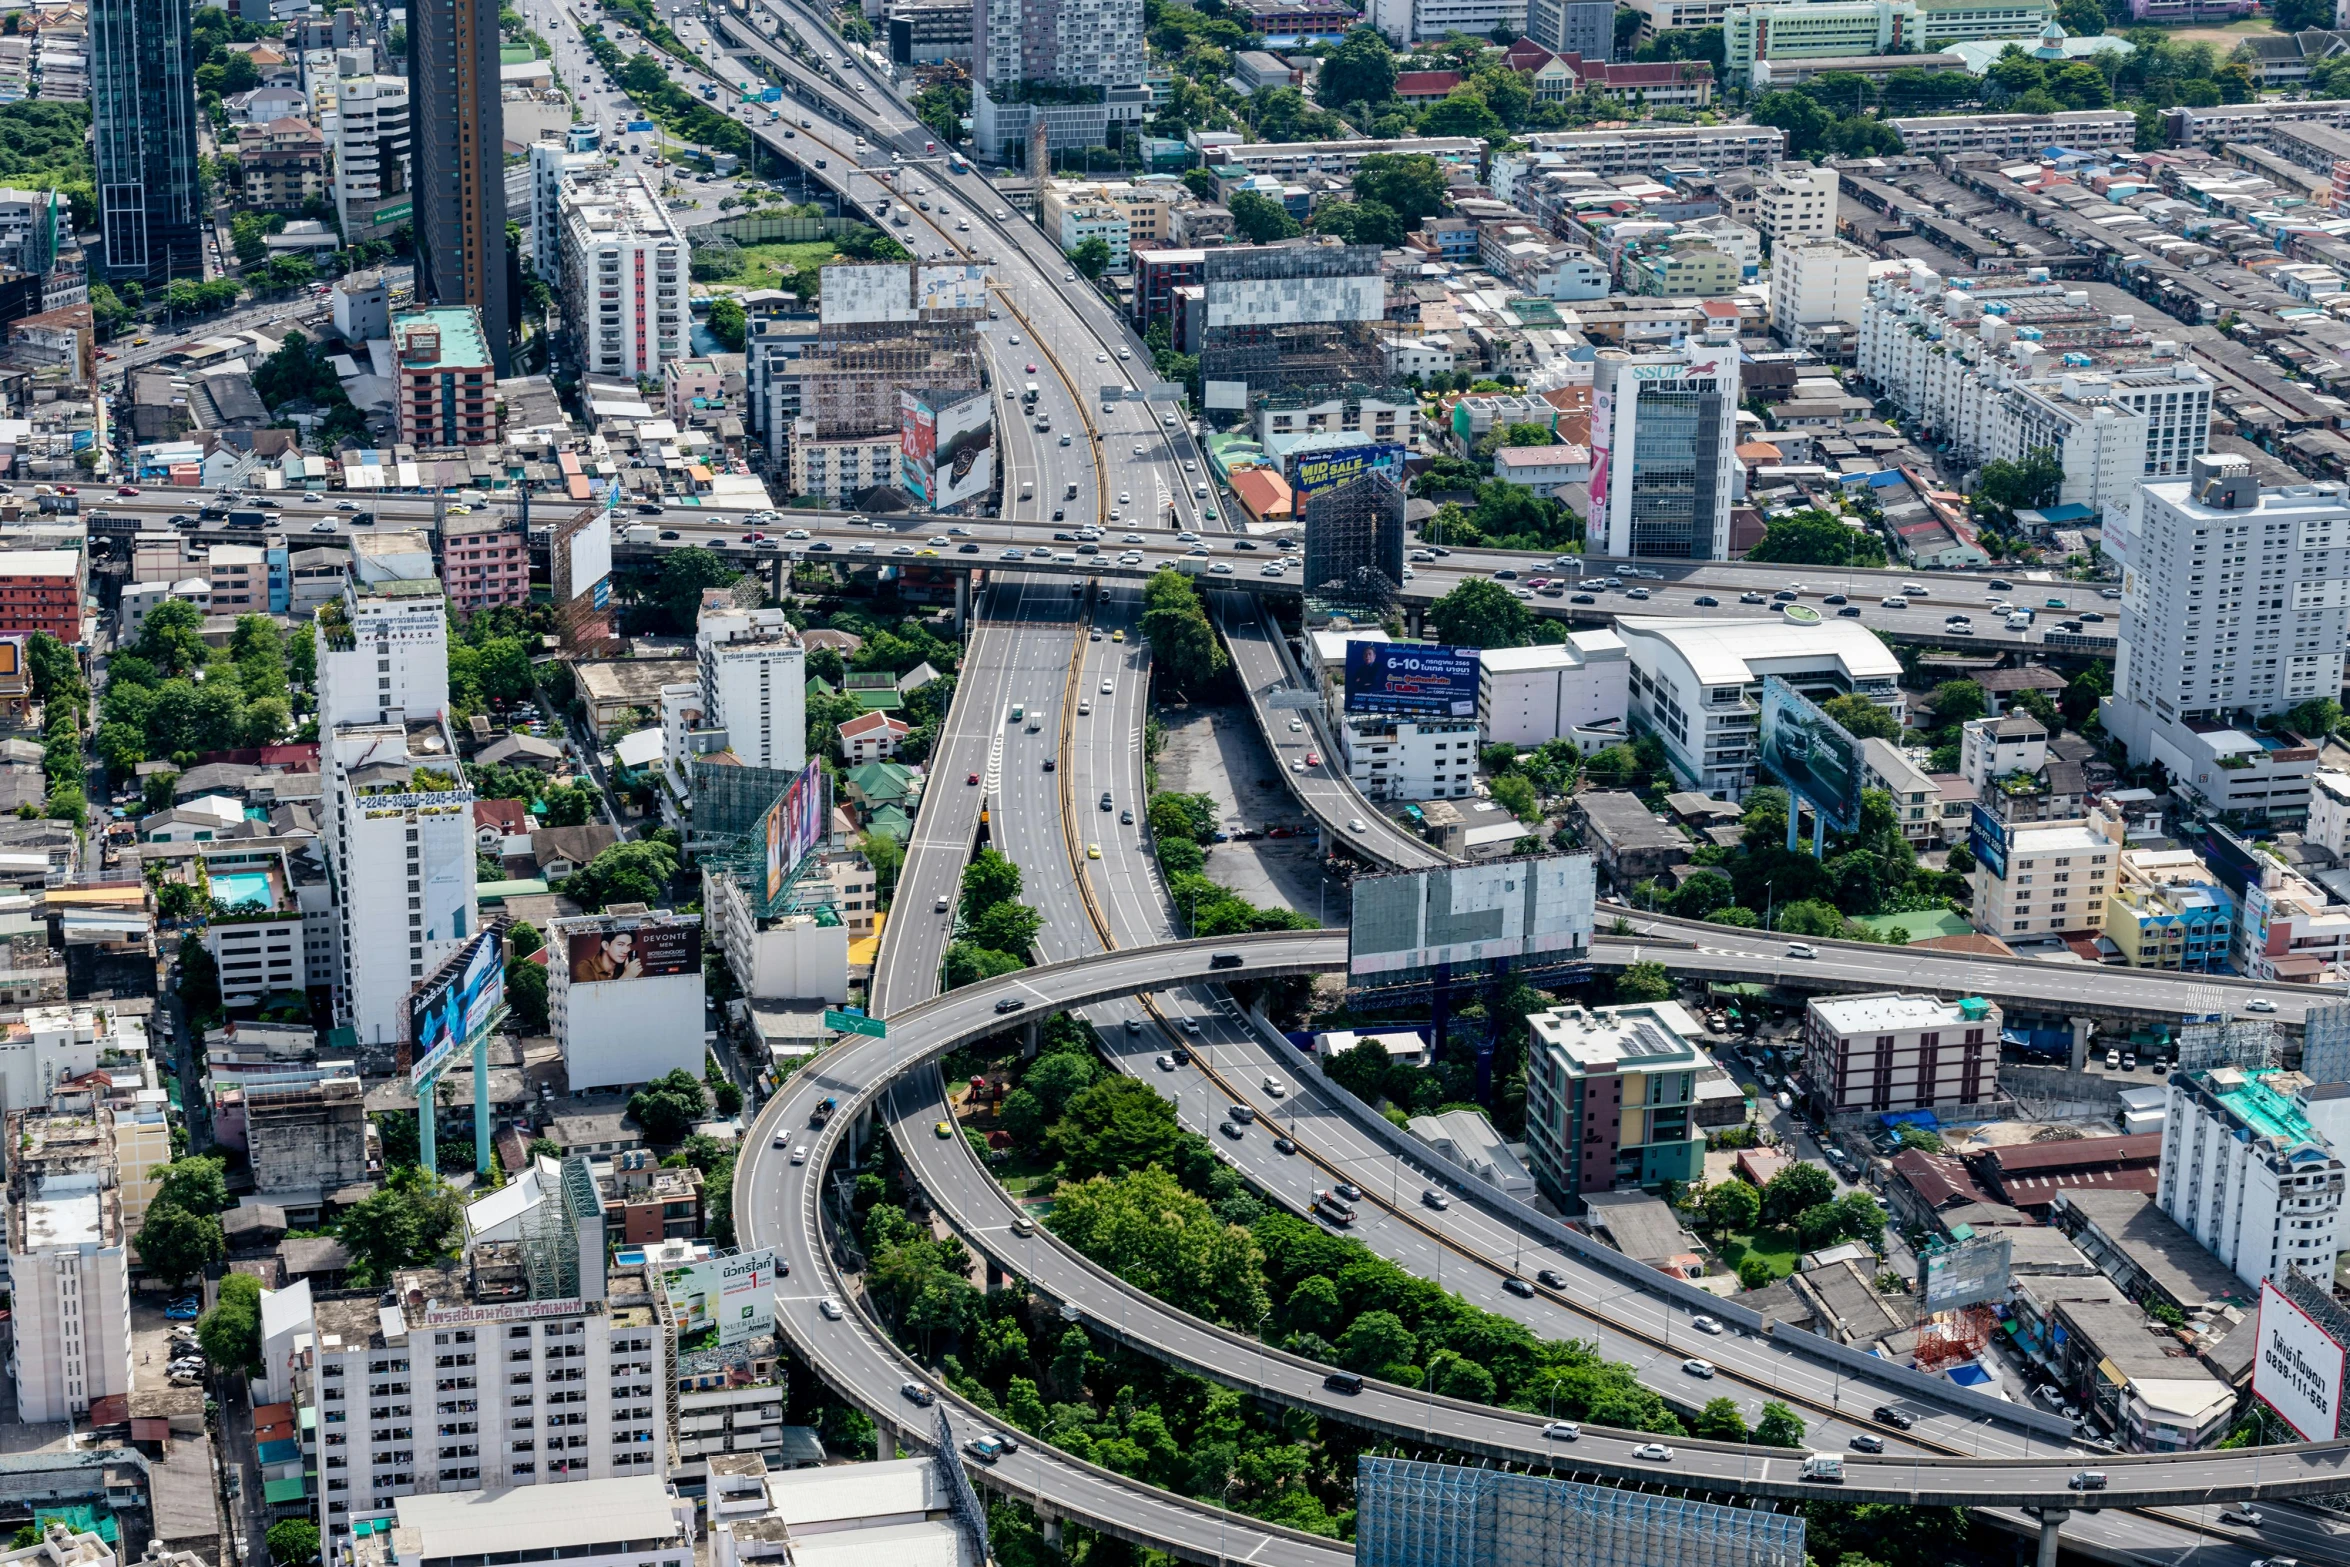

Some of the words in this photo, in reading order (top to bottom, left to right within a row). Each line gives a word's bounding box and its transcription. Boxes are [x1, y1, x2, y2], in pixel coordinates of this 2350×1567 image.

[1632, 365, 1684, 380] SSUP
[1301, 461, 1328, 478] MID
[1329, 457, 1363, 475] SALE
[1302, 472, 1328, 485] YEAR
[1387, 657, 1420, 670] 6-10
[1420, 664, 1443, 672] ไบเทค
[723, 1256, 772, 1278] นิวทริไลท์
[748, 1272, 757, 1289] 1
[723, 1314, 772, 1331] NUTRILITE
[747, 1322, 771, 1334] Amway
[2273, 1328, 2326, 1393] ให้เช่าโฆษณา
[2265, 1349, 2328, 1415] 0899-111-555
